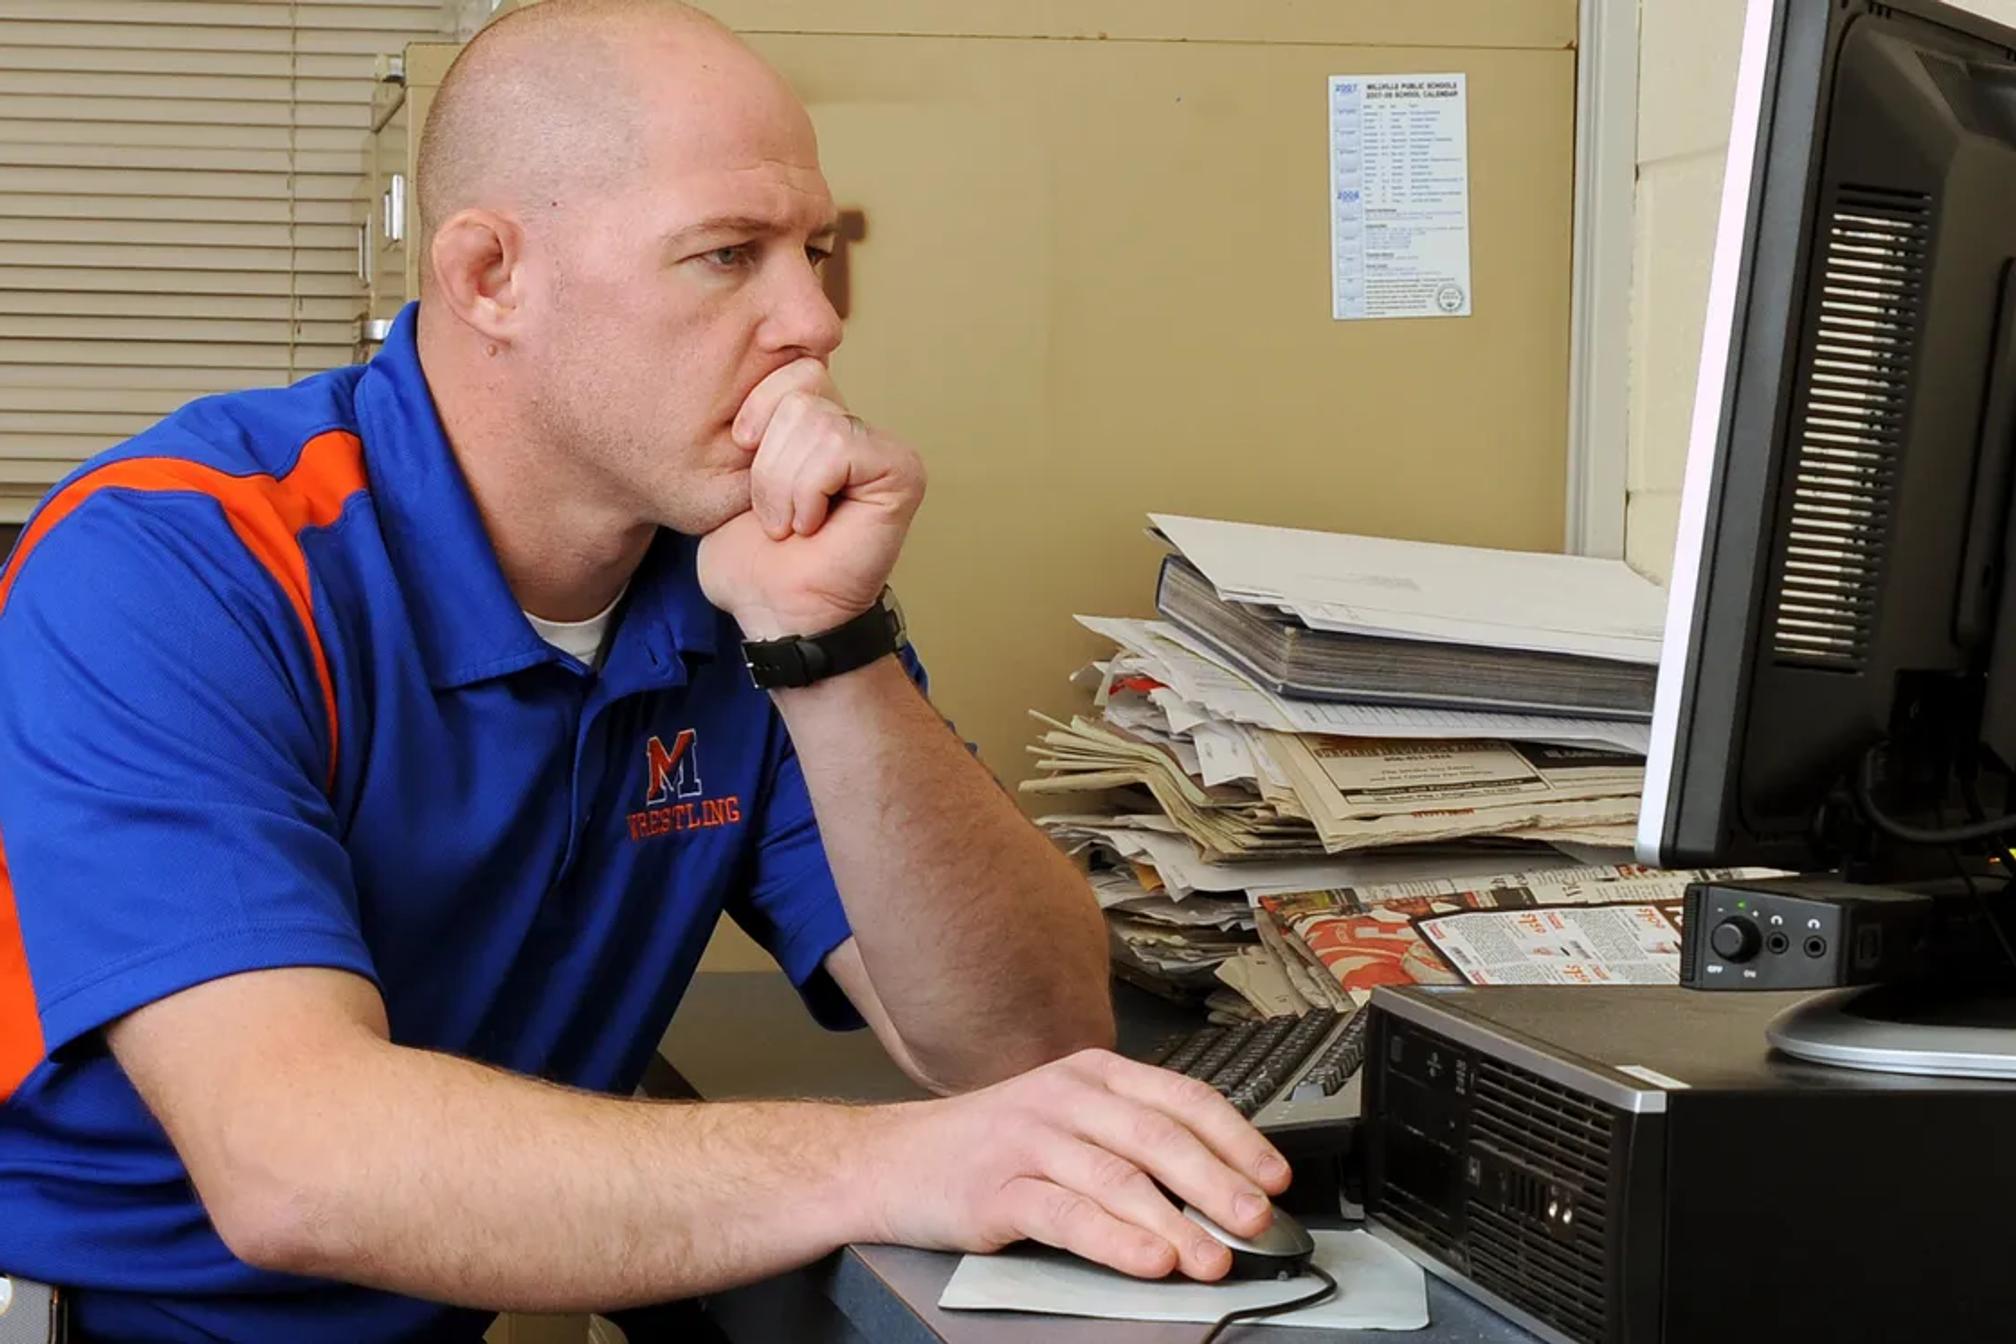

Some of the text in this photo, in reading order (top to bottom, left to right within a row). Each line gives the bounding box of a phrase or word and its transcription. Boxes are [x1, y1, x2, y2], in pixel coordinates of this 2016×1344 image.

[1366, 81, 1458, 91] MILLVILLE PUBLIC SCHOOLS
[1394, 91, 1421, 99] SCHOOL
[1423, 90, 1459, 98] CALENDAR
[646, 727, 702, 807] M
